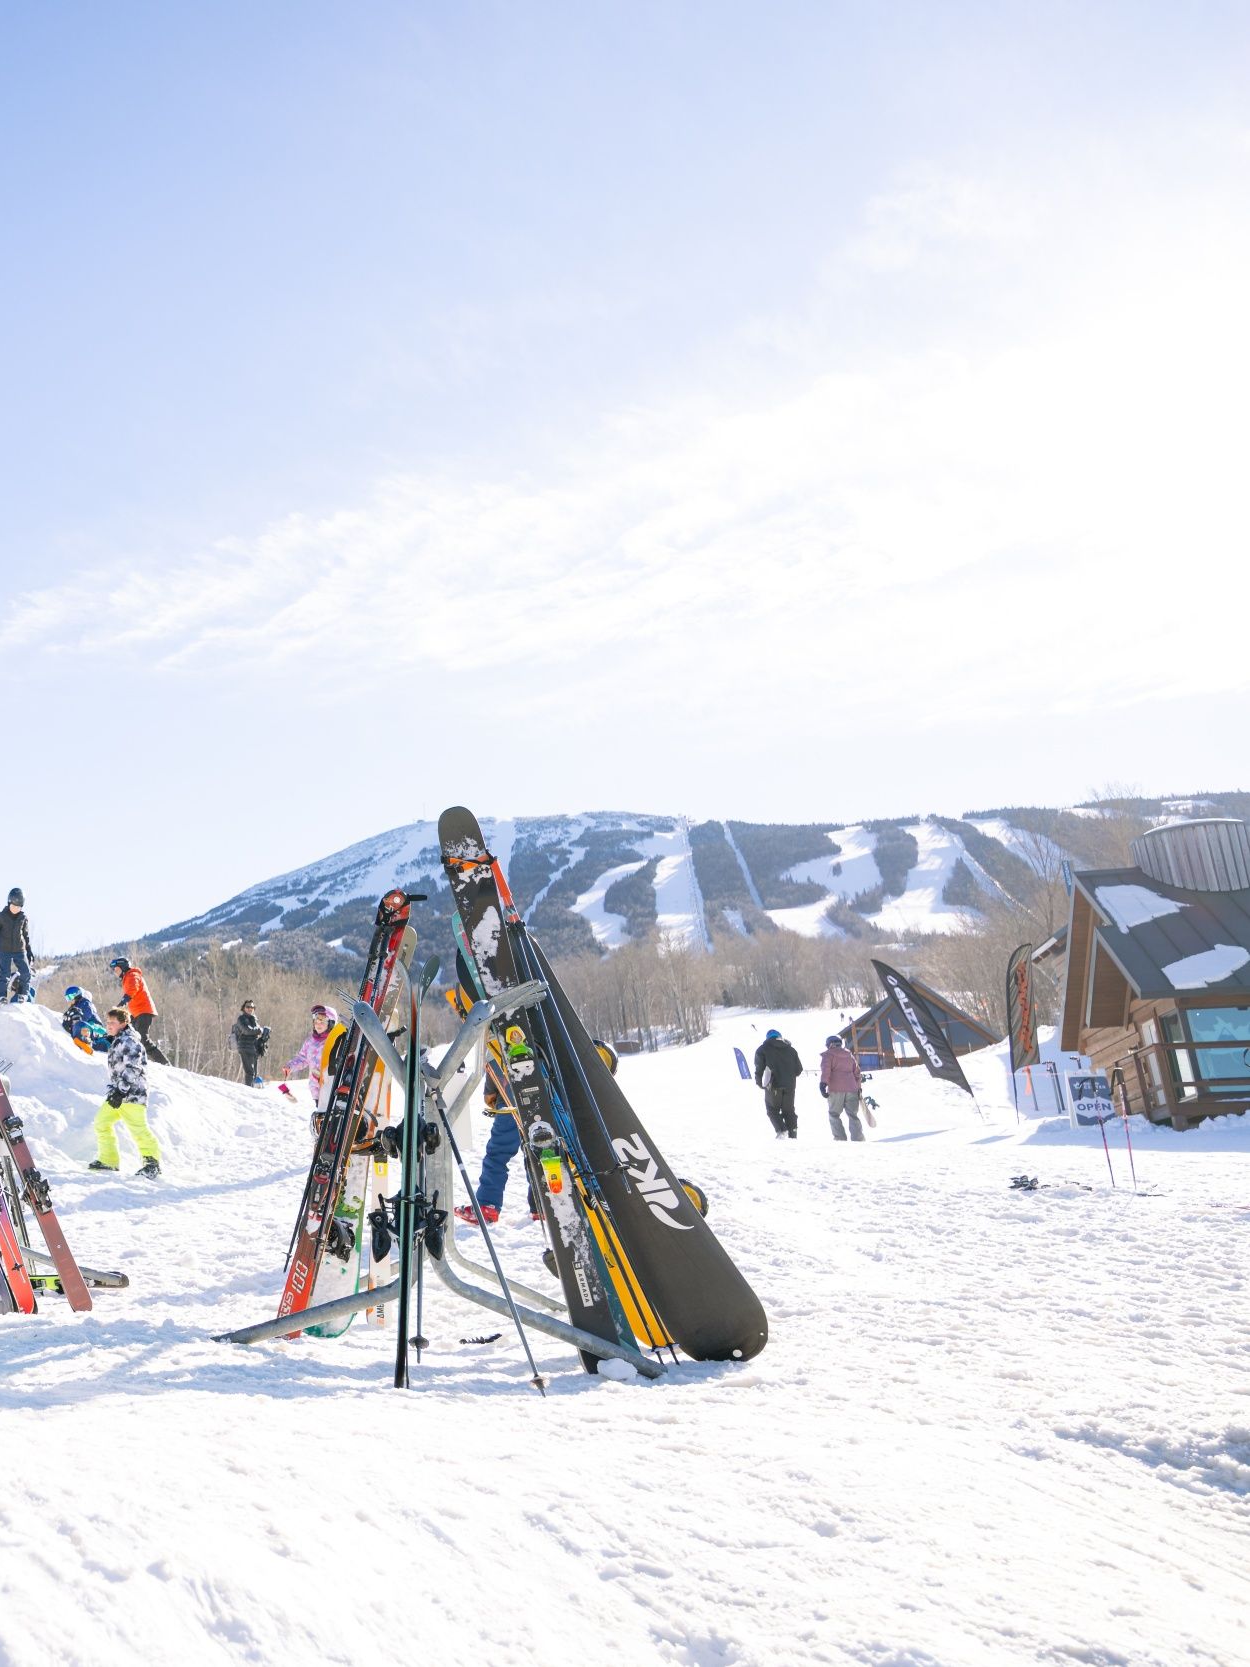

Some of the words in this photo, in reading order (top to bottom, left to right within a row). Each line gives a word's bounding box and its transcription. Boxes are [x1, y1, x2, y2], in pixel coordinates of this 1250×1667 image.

[893, 986, 943, 1068] BLIZZARD
[1077, 1103, 1112, 1111] OPEN
[291, 1259, 309, 1294] 100
[578, 1273, 590, 1303] ARMADA
